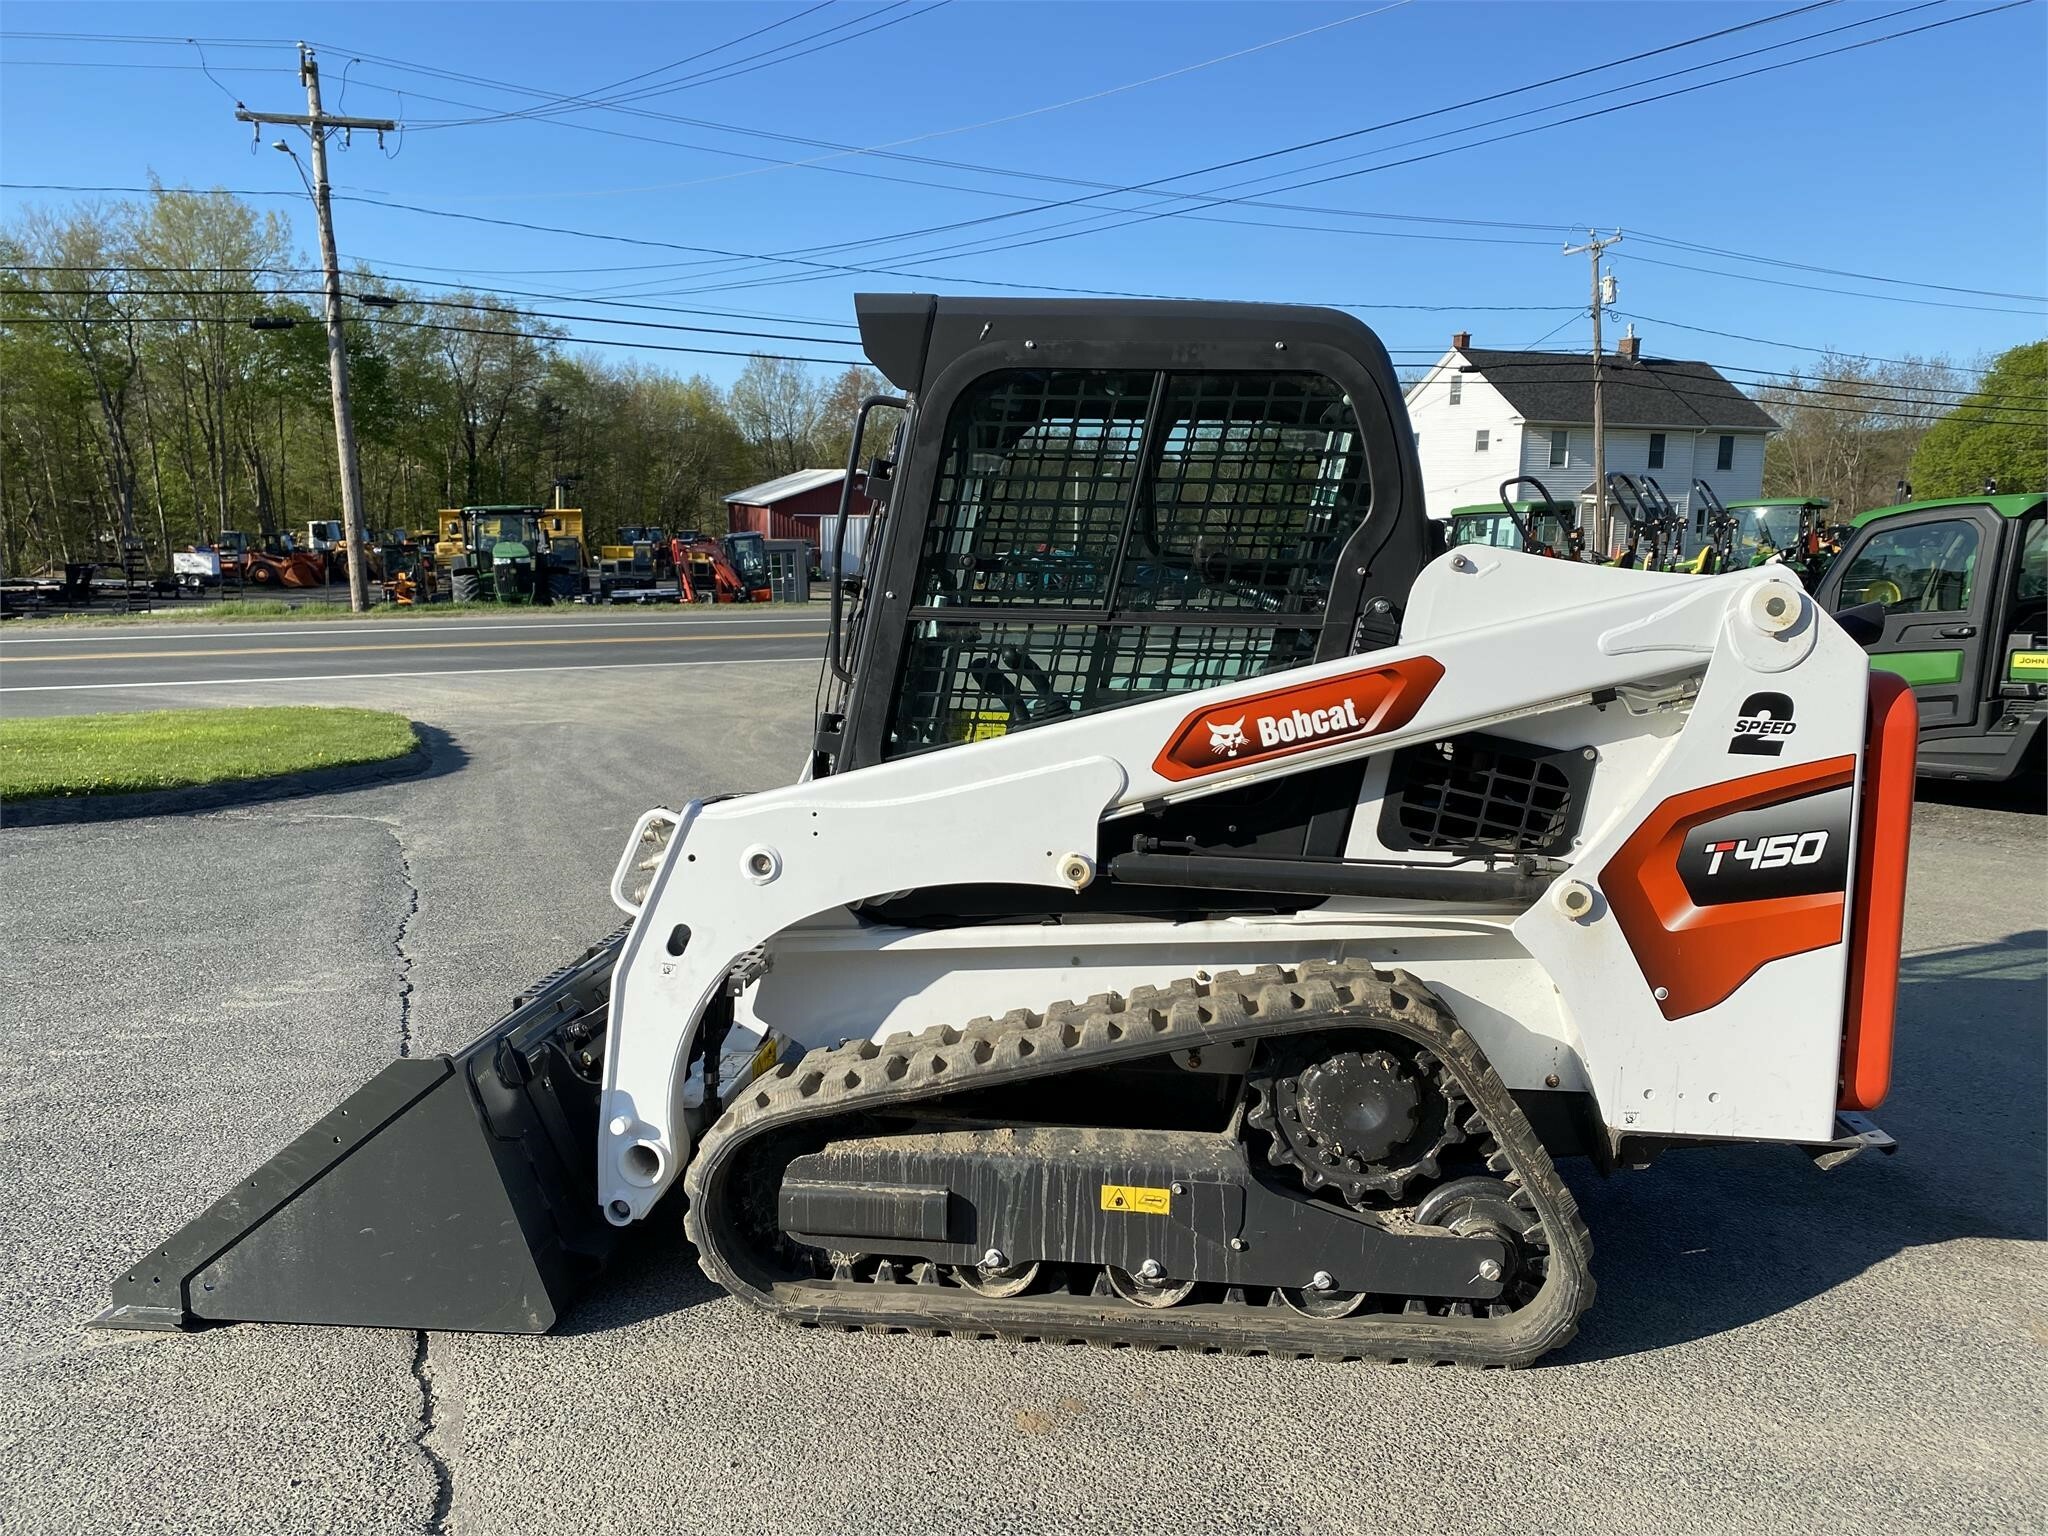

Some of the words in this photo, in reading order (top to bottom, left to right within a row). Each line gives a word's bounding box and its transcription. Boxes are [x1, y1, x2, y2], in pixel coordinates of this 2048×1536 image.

[1257, 698, 1359, 746] Bobcat
[1727, 691, 1794, 756] 2
[1734, 719, 1796, 735] SPEED
[1704, 830, 1829, 876] T450
